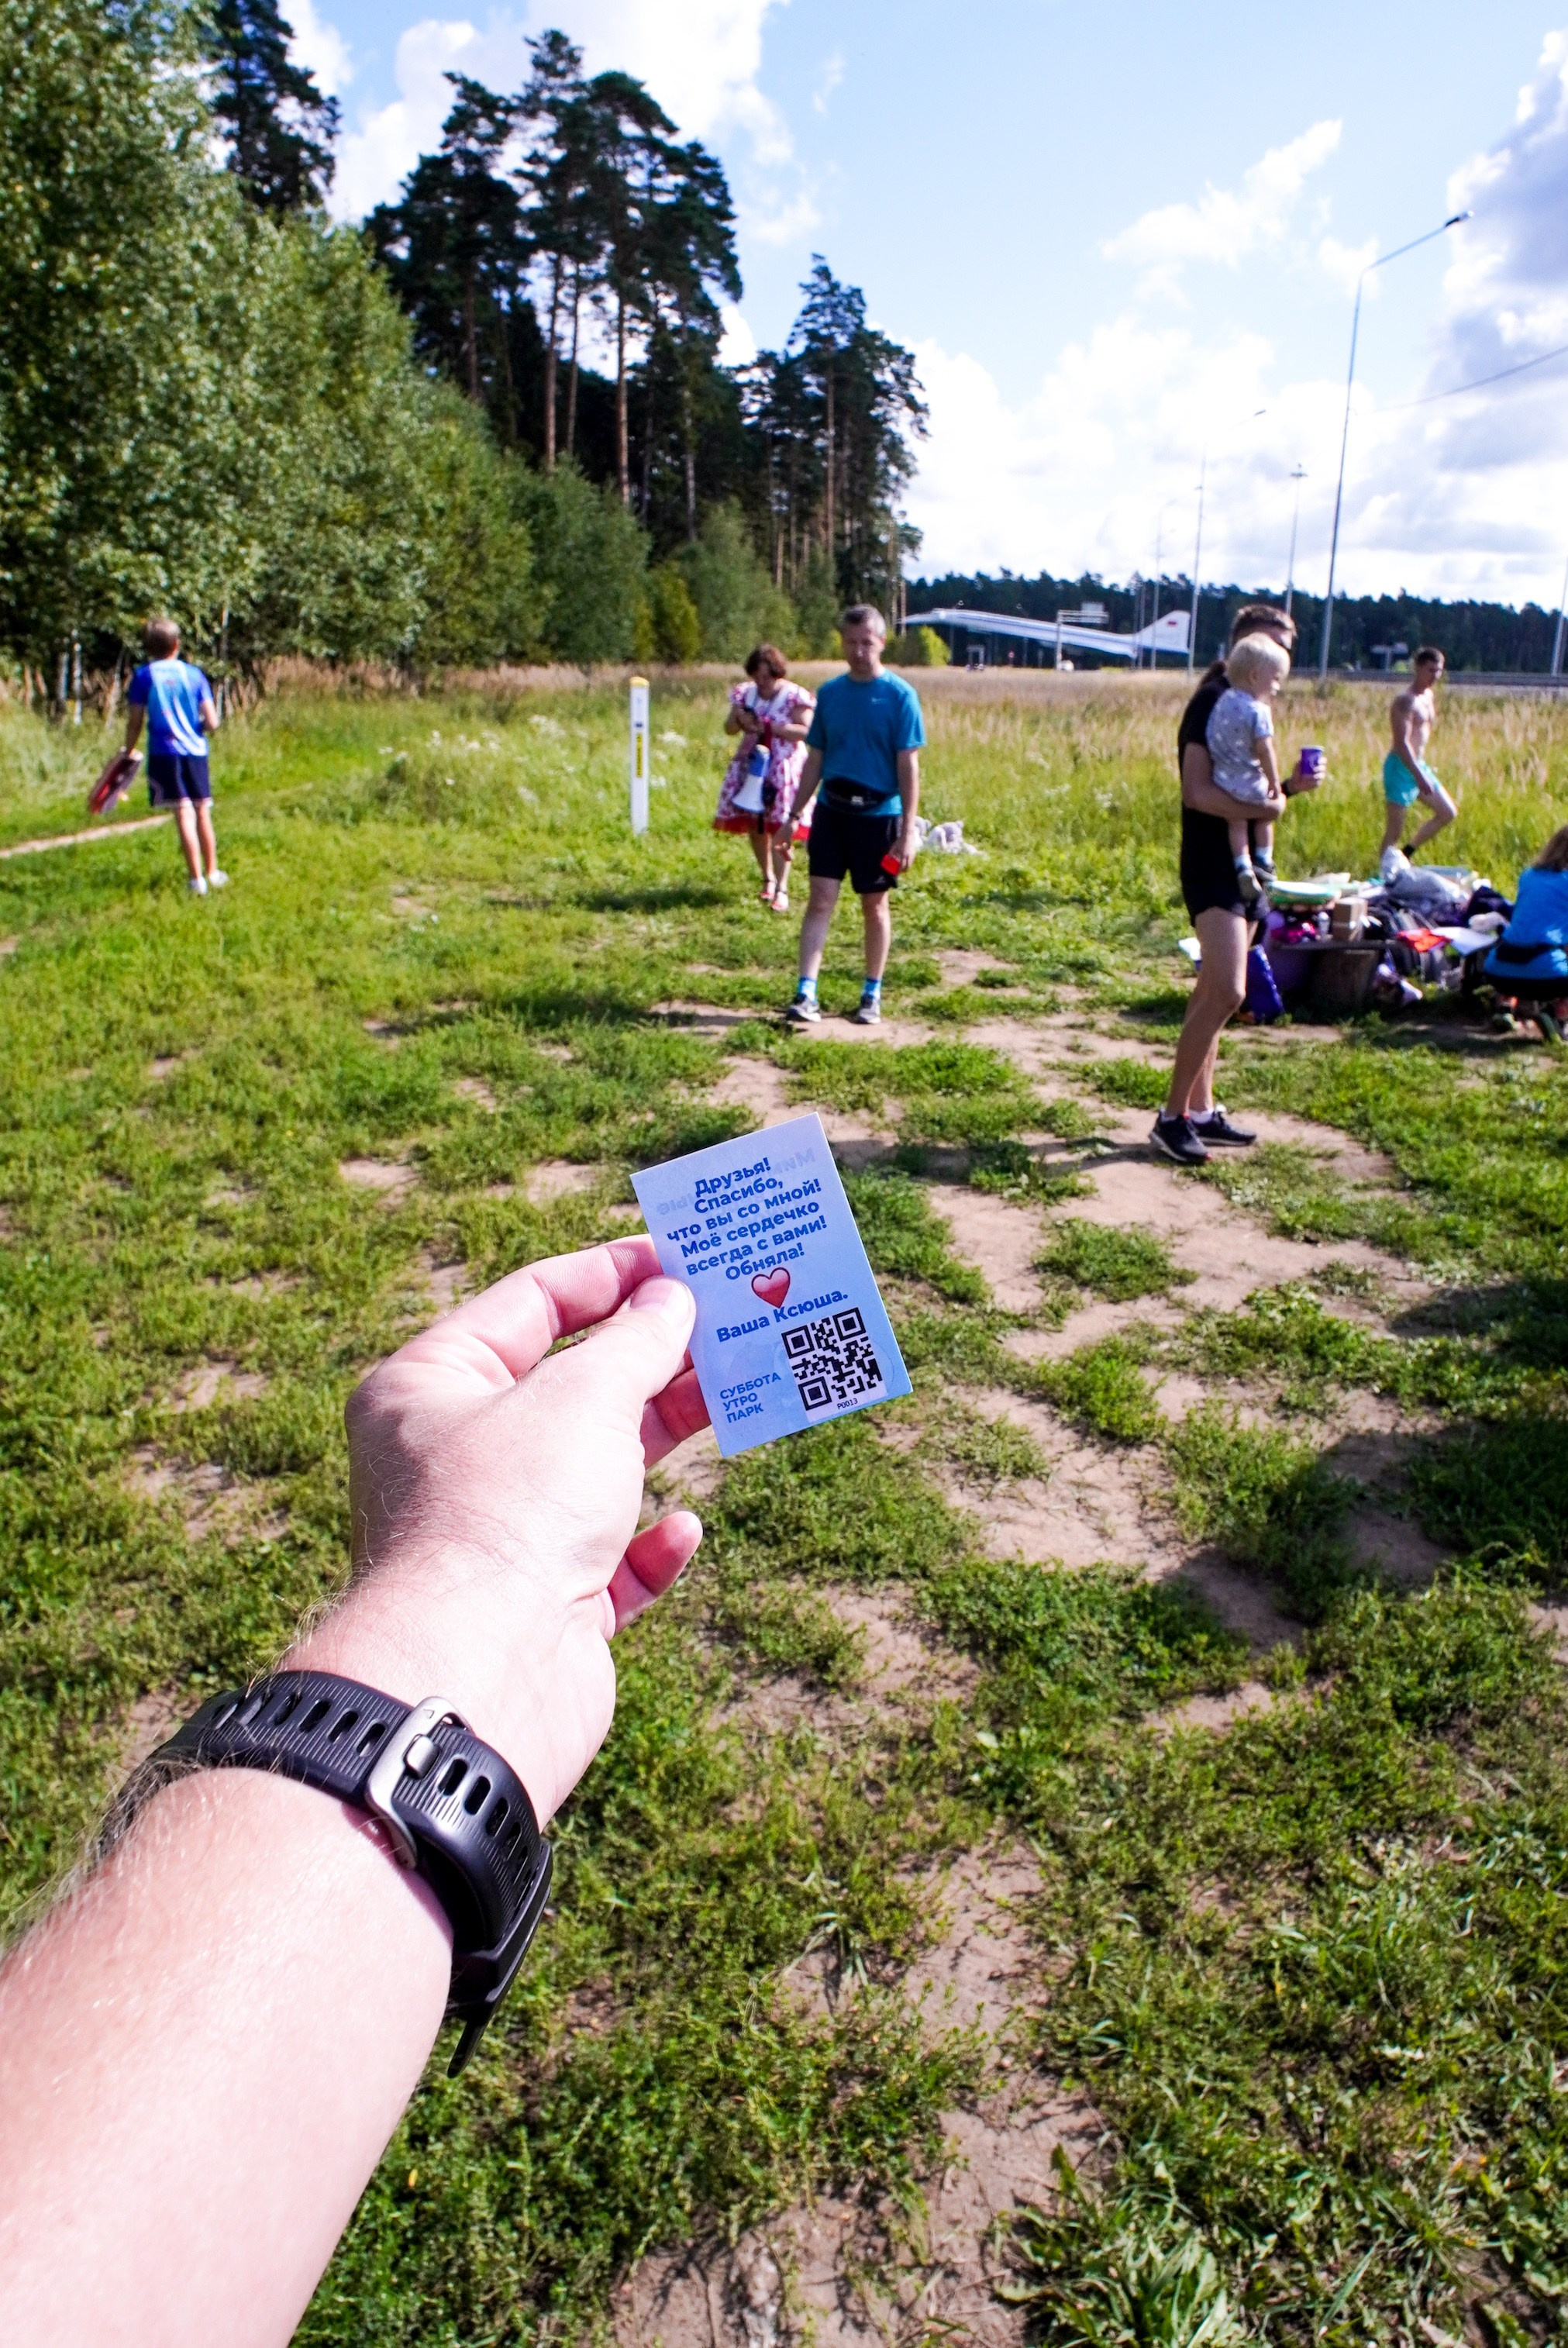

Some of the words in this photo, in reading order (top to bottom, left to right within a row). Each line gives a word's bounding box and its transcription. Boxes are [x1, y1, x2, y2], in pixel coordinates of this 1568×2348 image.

[694, 1157, 771, 1198] Друзья!
[694, 1177, 783, 1214] Спасибо,
[667, 1223, 701, 1241] что
[705, 1212, 733, 1230] вы
[737, 1203, 760, 1219] со
[763, 1178, 822, 1210] мной!
[681, 1232, 722, 1258] Моё
[726, 1202, 819, 1241] сердечко
[686, 1244, 753, 1276] всегда
[756, 1239, 769, 1250] с
[772, 1215, 827, 1246] вами!
[725, 1242, 805, 1281] Обняла!
[716, 1316, 770, 1343] Ваша
[773, 1291, 849, 1323] Ксюша.
[719, 1372, 782, 1399] СУББОТА
[722, 1392, 758, 1412] УТРО
[836, 1398, 858, 1410] P0013
[726, 1402, 764, 1423] ПАРК
